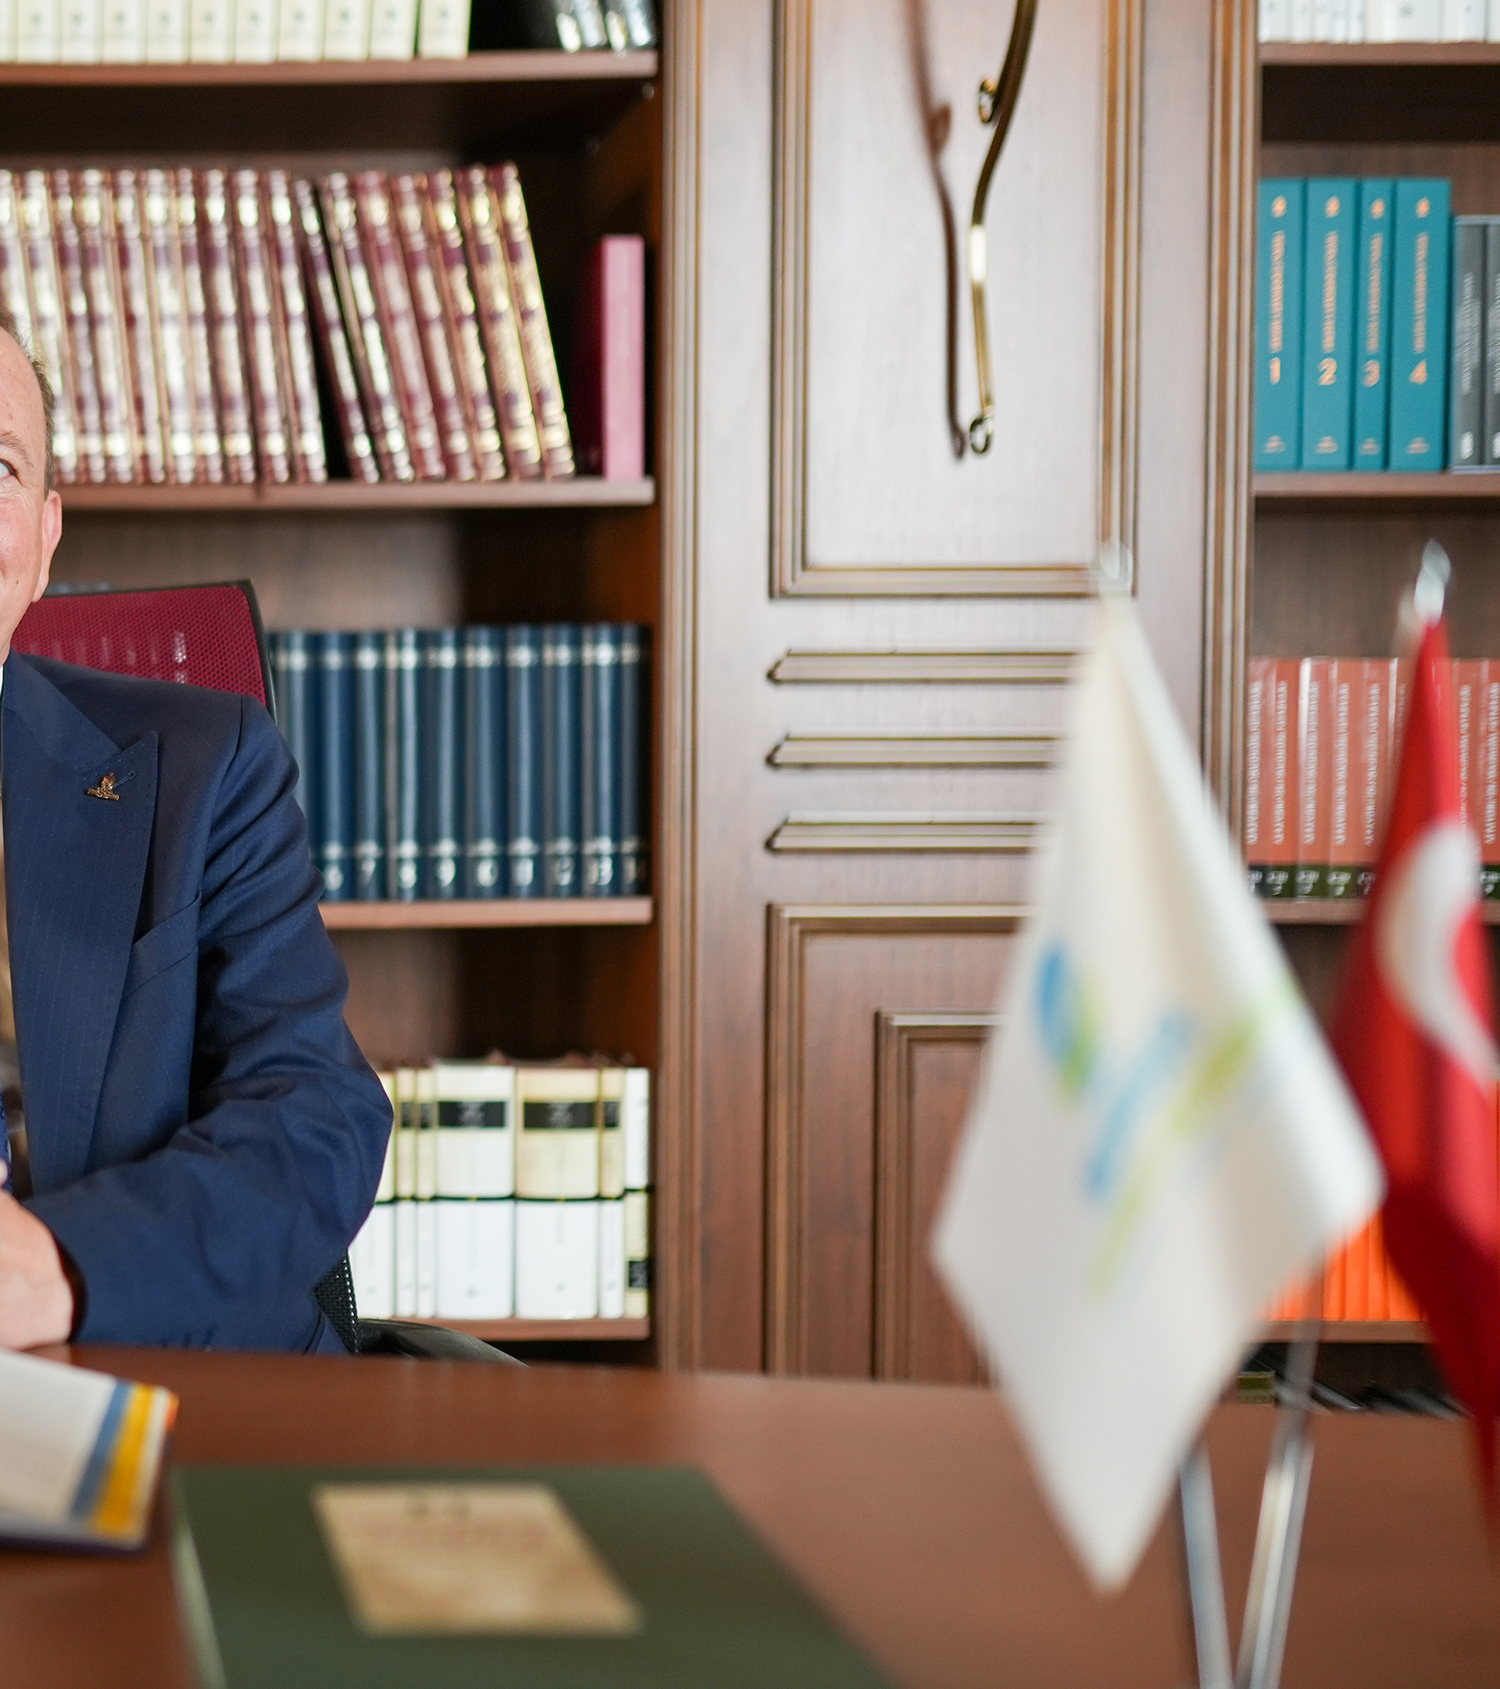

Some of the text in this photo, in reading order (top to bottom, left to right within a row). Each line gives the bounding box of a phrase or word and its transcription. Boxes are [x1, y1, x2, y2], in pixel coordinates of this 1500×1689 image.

[1318, 357, 1338, 386] 2
[1362, 359, 1381, 387] 3
[1409, 359, 1428, 385] 4
